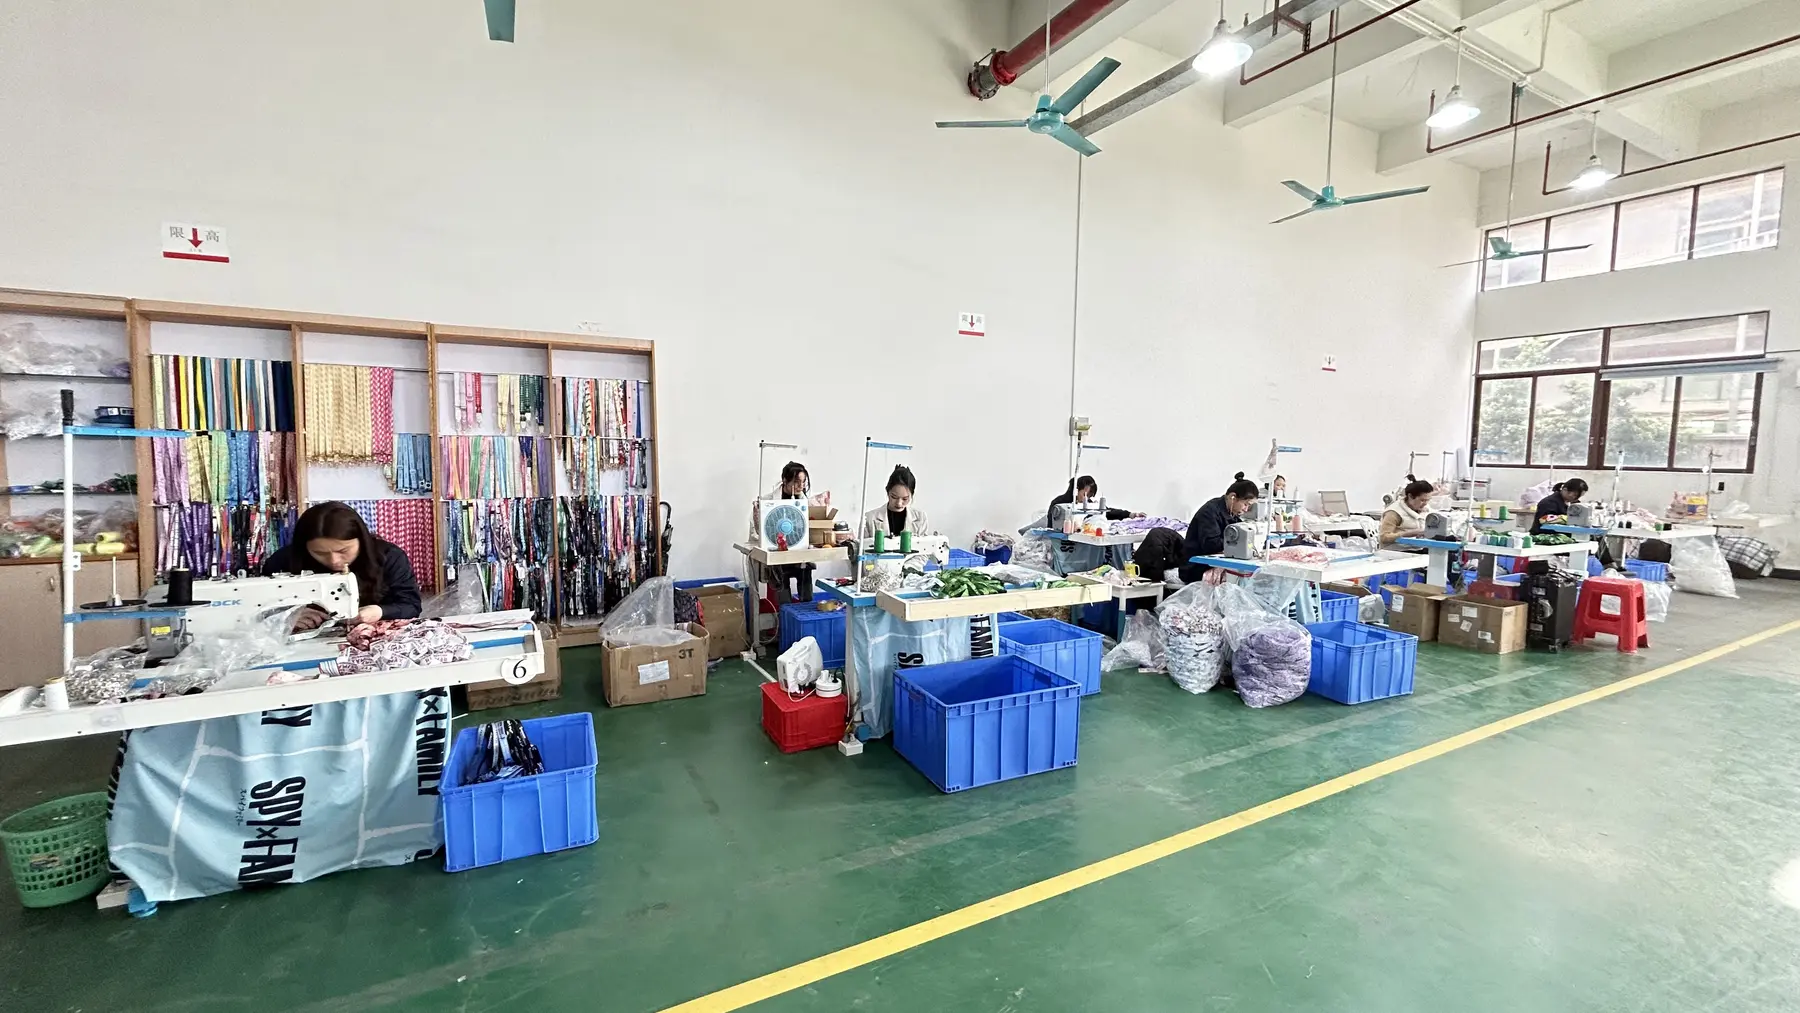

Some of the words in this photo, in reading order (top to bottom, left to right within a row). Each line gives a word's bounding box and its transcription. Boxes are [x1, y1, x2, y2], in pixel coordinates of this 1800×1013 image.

[204, 229, 220, 243] 高
[970, 615, 994, 659] FAMI
[679, 648, 694, 659] 3T
[897, 652, 924, 669] S
[513, 658, 527, 679] 6
